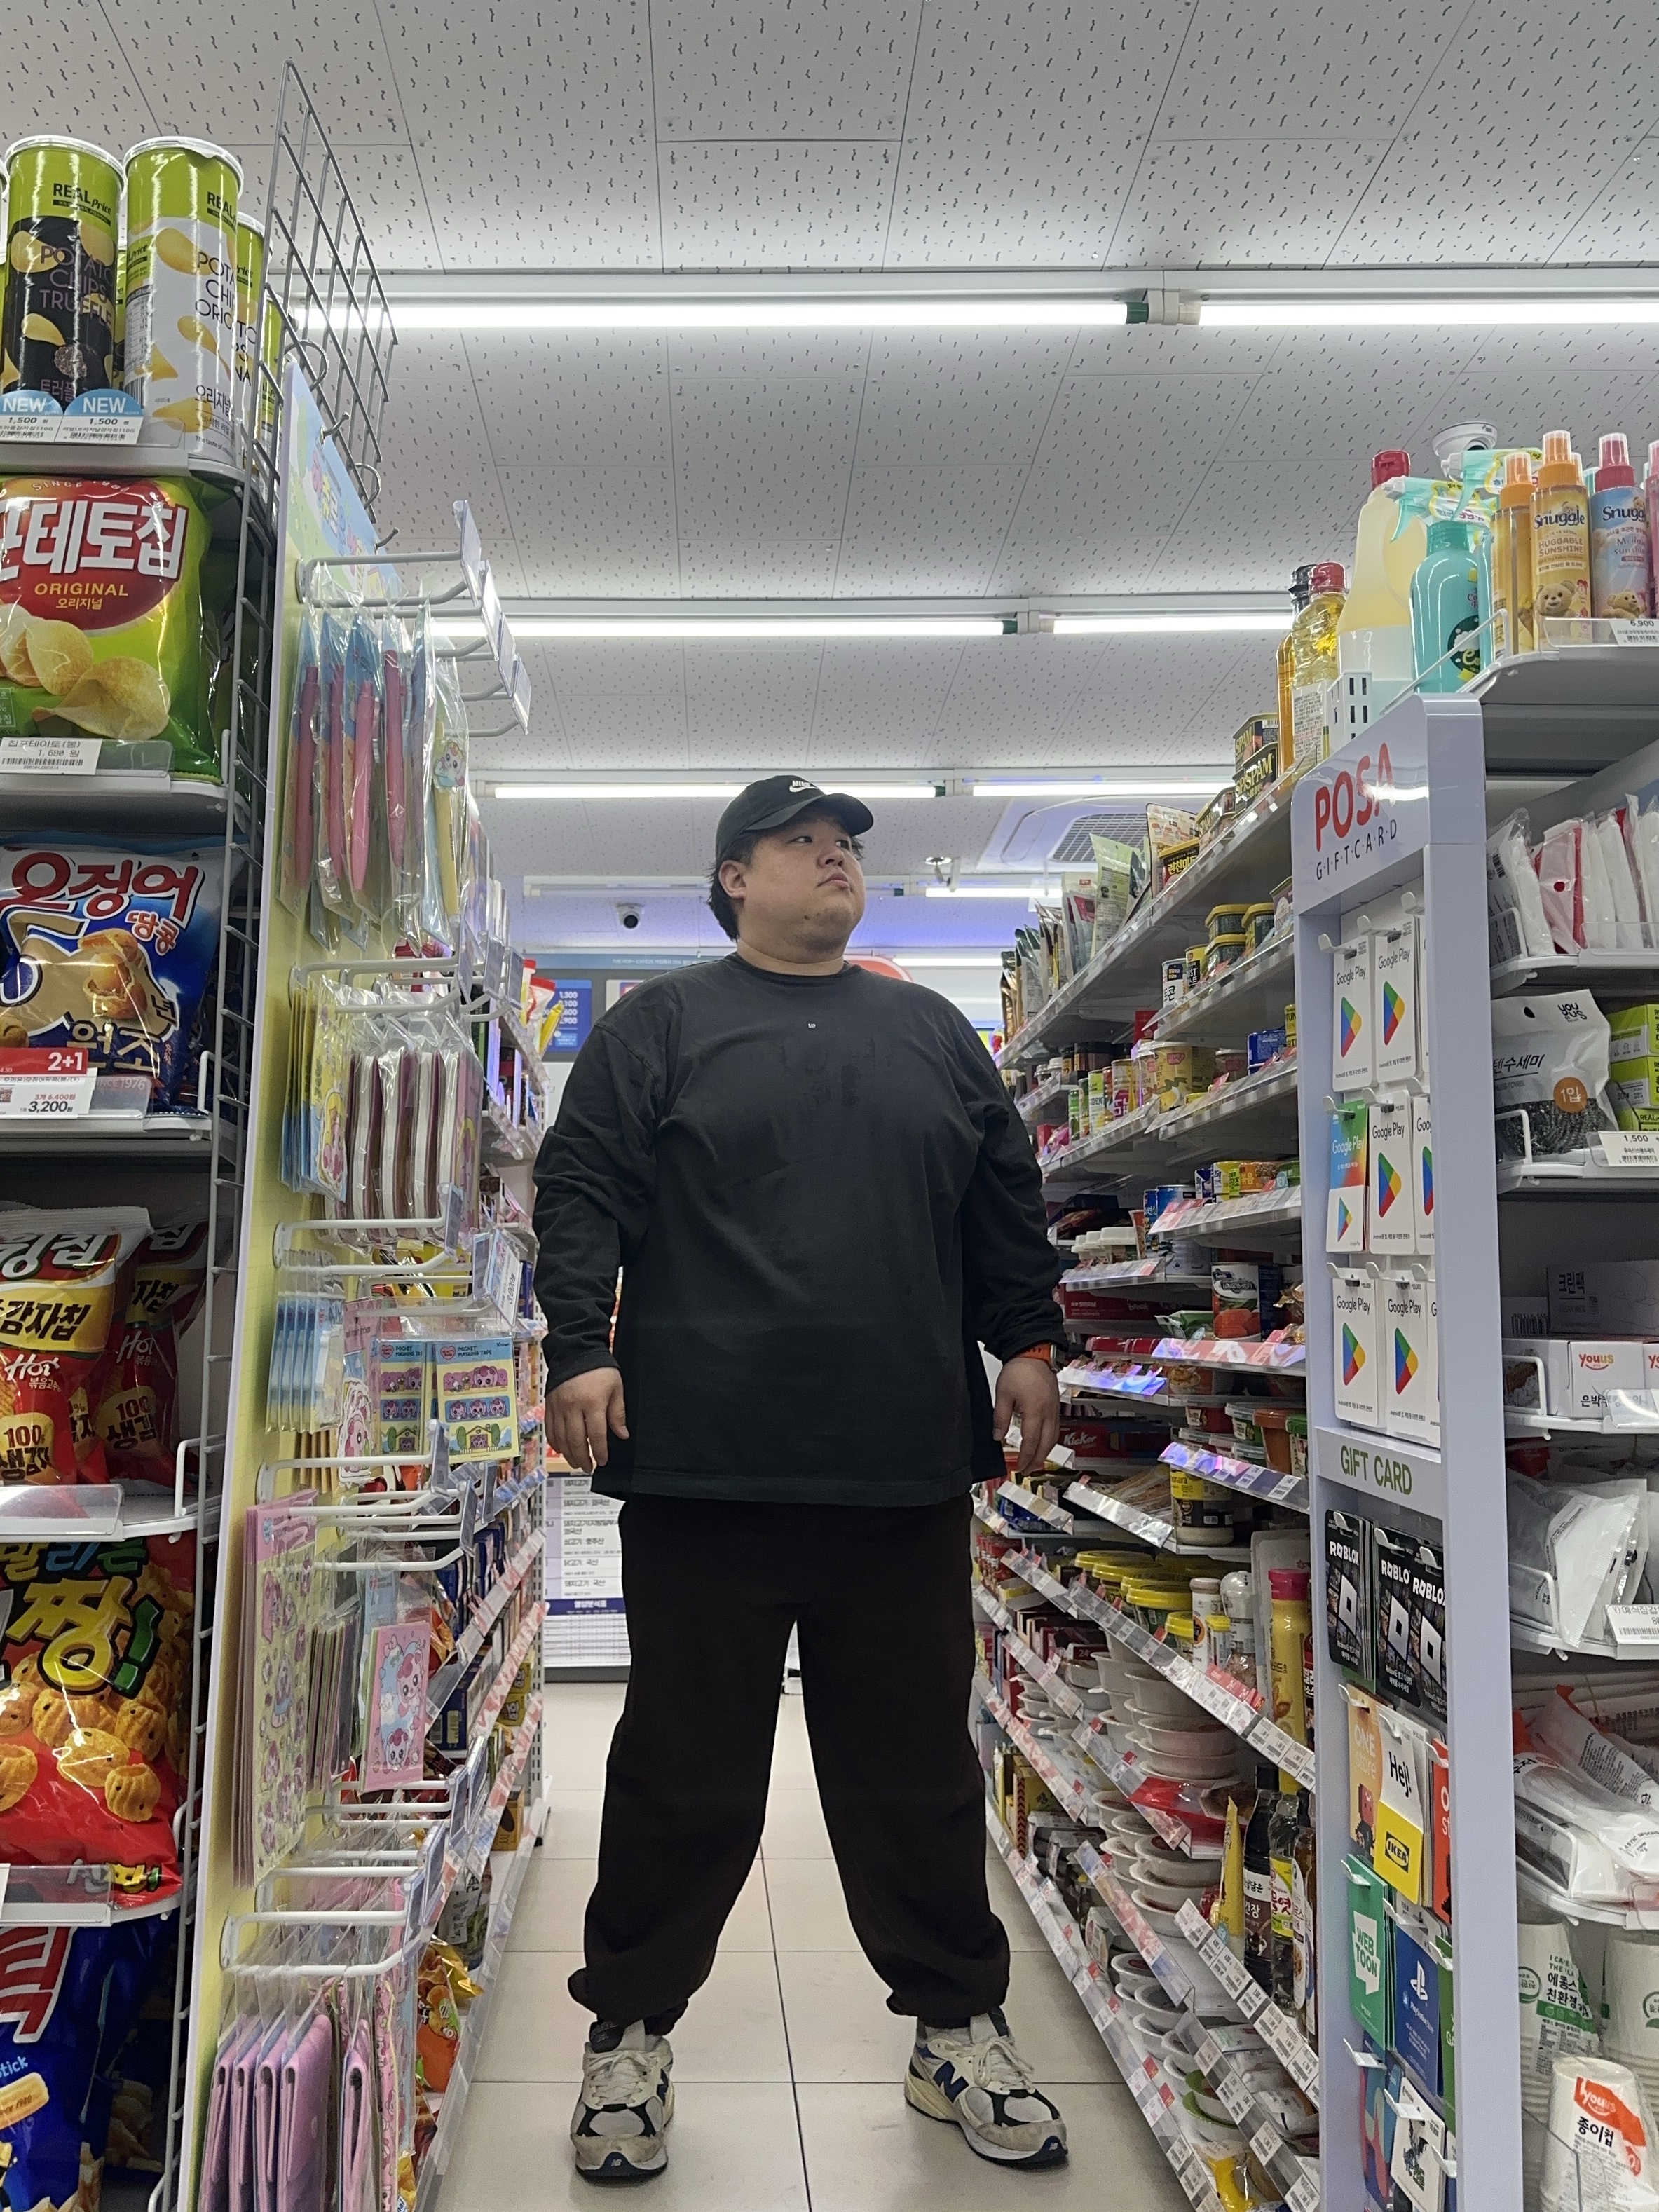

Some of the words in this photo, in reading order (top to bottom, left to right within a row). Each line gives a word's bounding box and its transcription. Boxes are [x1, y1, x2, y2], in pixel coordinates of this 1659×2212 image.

[53, 183, 91, 205] REAL
[50, 270, 107, 304] CHIPS
[40, 289, 112, 327] TRUFFLE
[3, 397, 46, 413] NEW
[83, 397, 127, 414] NEW
[1534, 507, 1585, 530] Snuggle
[1602, 505, 1647, 525] Snugg
[1538, 537, 1584, 549] HUGGABLE
[1538, 546, 1584, 558] SUNSHINE
[34, 582, 129, 597] ORIGINAL
[55, 598, 103, 610] 오리지널
[1245, 753, 1274, 789] SPAM
[0, 851, 200, 922] 오징어
[127, 911, 177, 955] 땅콩
[1379, 953, 1398, 969] Google
[1398, 948, 1411, 965] Play
[1336, 969, 1354, 985] Google
[1355, 965, 1367, 982] Play
[48, 1051, 83, 1072] 2+1
[1560, 1085, 1582, 1104] 1입
[1372, 1125, 1392, 1140] Google
[1393, 1124, 1405, 1139] Play
[1332, 1140, 1351, 1156] Google
[1351, 1136, 1364, 1151] Play
[1336, 1295, 1357, 1312] Google
[1358, 1297, 1371, 1315] Play
[1388, 1299, 1407, 1316] Google
[1408, 1302, 1421, 1319] Play
[1579, 1353, 1615, 1369] youus
[1340, 1445, 1369, 1482] GIFT
[1374, 1454, 1412, 1496] CARD
[1330, 1541, 1359, 1566] ROBLOX
[1381, 1559, 1411, 1585] ROBLO
[1388, 1751, 1412, 1798] Hej!
[1387, 1840, 1407, 1864] IKEA
[1356, 1927, 1377, 1956] WEB
[1354, 1942, 1379, 1979] TOON
[1576, 2115, 1616, 2148] 종이컵
